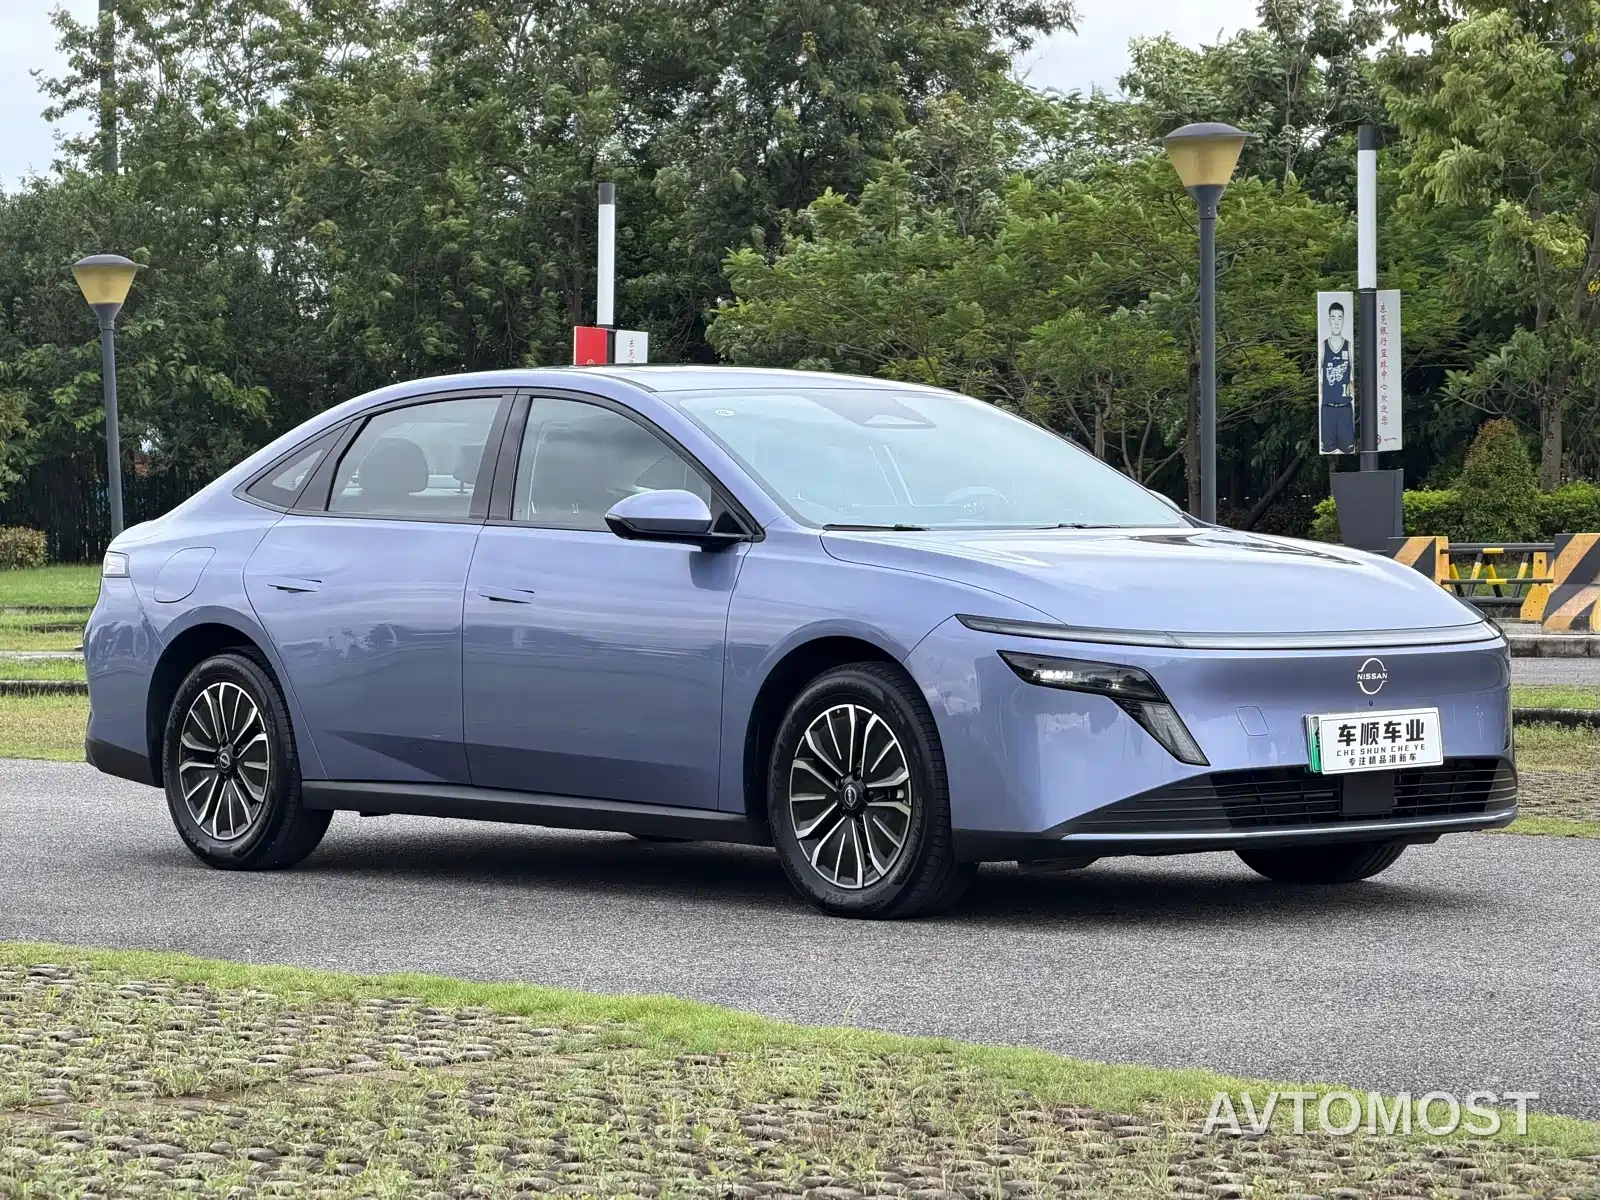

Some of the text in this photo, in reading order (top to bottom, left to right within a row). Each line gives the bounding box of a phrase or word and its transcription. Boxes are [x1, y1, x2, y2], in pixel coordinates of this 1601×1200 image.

[1356, 672, 1388, 680] NISSAN
[1337, 719, 1425, 746] 车顺车业
[1336, 743, 1426, 757] CHE SHUN CHE YE
[1348, 753, 1417, 766] 专注精品准新车
